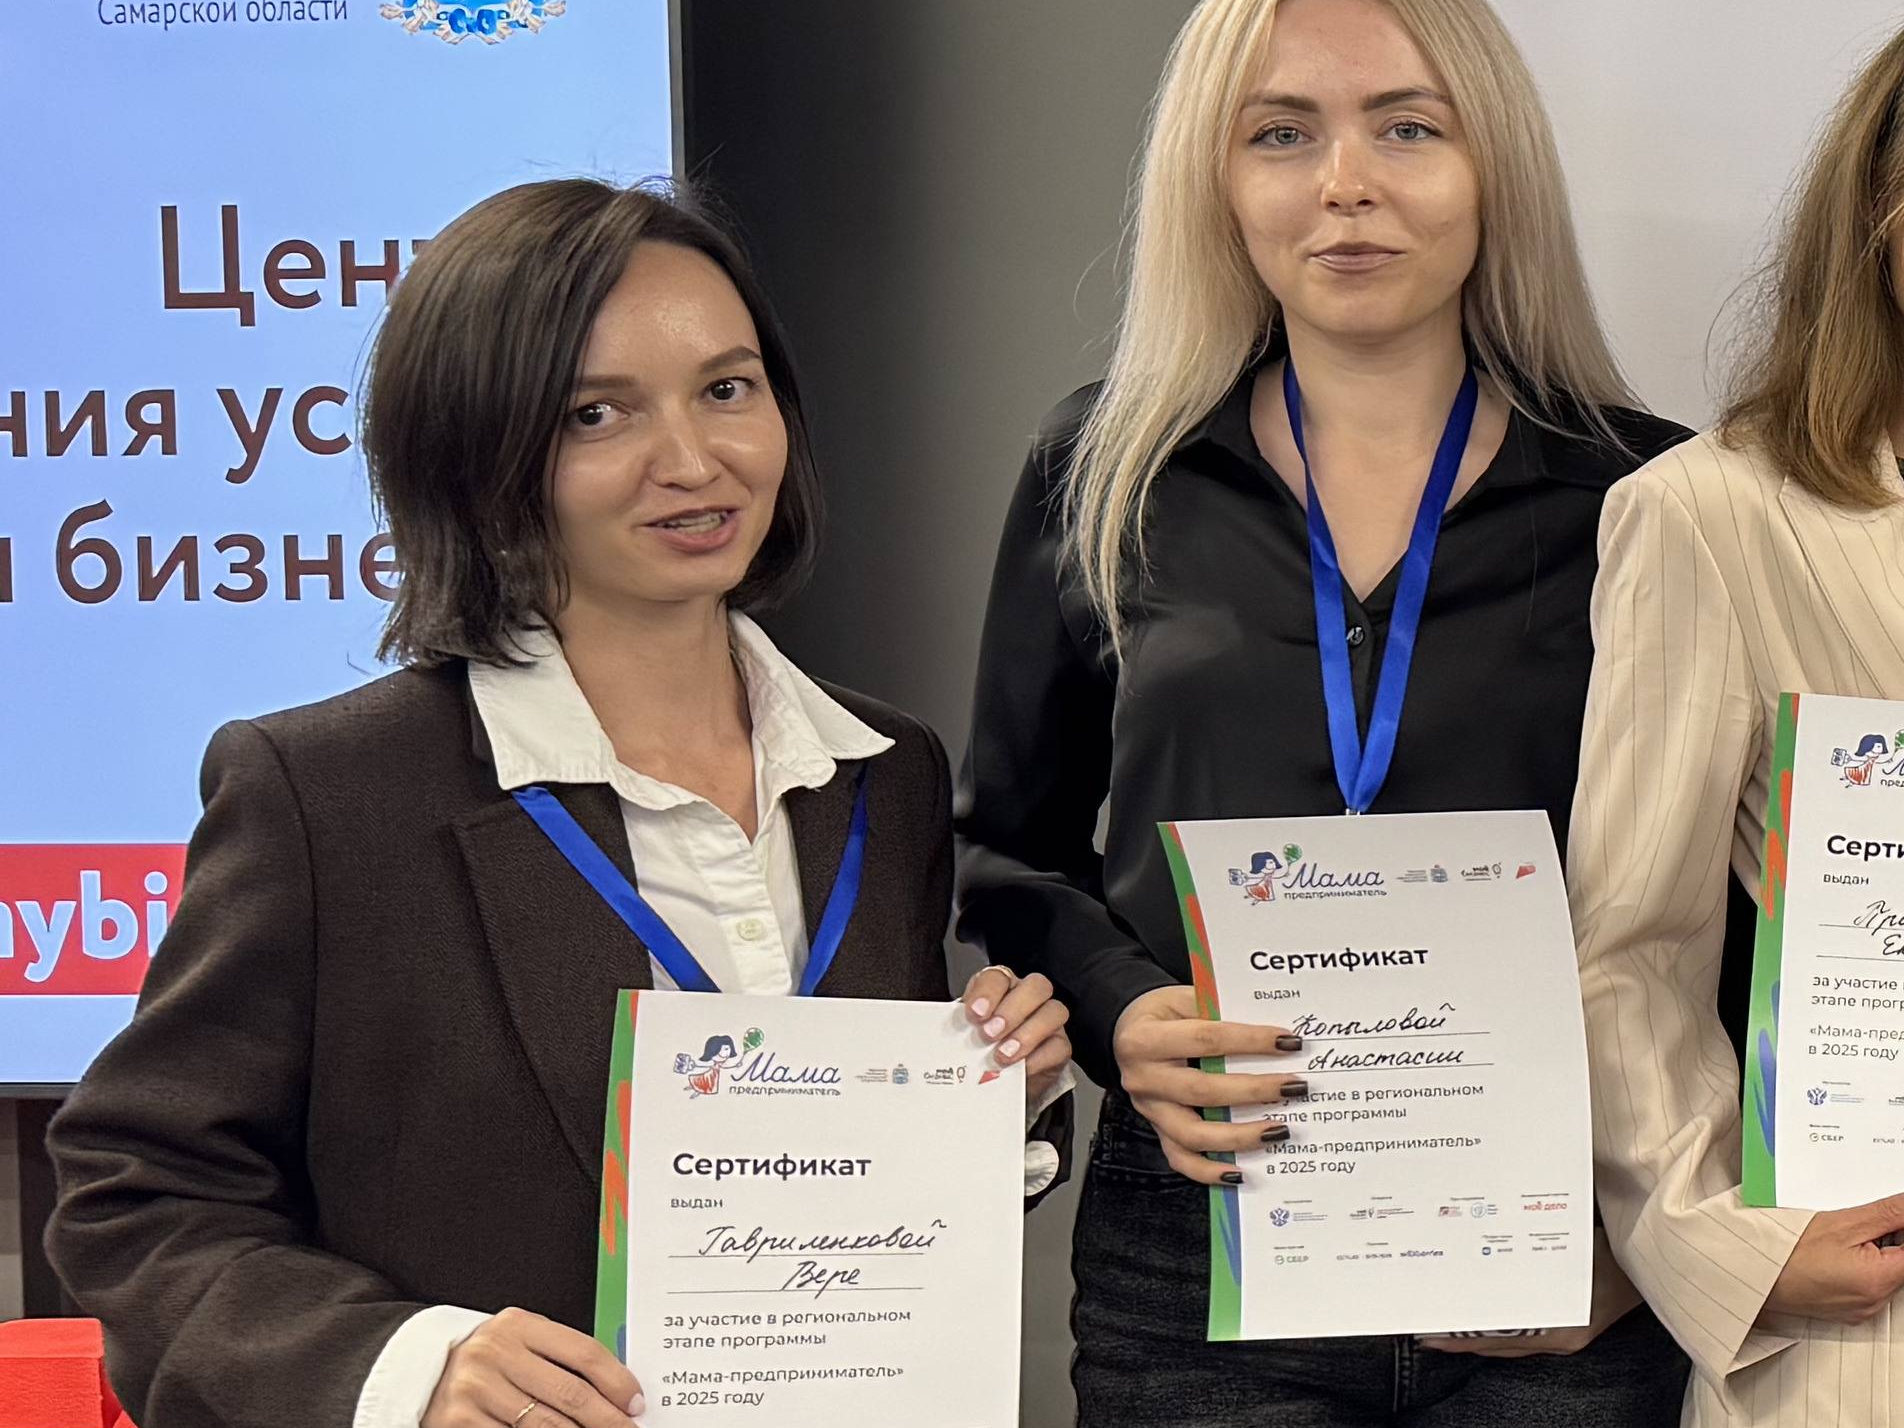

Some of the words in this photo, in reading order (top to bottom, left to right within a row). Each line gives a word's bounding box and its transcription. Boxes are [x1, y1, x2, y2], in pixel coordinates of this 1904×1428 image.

[160, 204, 431, 327] Цен
[1282, 862, 1384, 889] Мама
[1823, 873, 1869, 885] выдан
[1249, 946, 1428, 974] Сертификат
[1812, 976, 1829, 986] за
[1833, 977, 1897, 990] участие
[1253, 989, 1300, 1000] выдан
[1811, 995, 1856, 1006] этапе
[1307, 1048, 1463, 1070] Анастасии
[1808, 1044, 1816, 1054] в
[1821, 1042, 1858, 1056] 2025
[1863, 1047, 1898, 1061] году
[730, 1050, 841, 1083] Мама
[1352, 1091, 1360, 1100] в
[1365, 1084, 1484, 1102] региональном
[1263, 1112, 1307, 1123] этапе
[1313, 1109, 1407, 1122] программы
[672, 1152, 871, 1181] Сертификат
[1267, 1164, 1275, 1174] в
[1280, 1161, 1316, 1174] 2025
[1321, 1161, 1356, 1175] году
[670, 1197, 723, 1209] выдан
[780, 1260, 860, 1299] Вере
[663, 1315, 684, 1327] за
[687, 1314, 761, 1330] участие
[766, 1313, 776, 1324] в
[782, 1311, 910, 1326] региональном
[663, 1336, 715, 1348] этапе
[720, 1334, 825, 1349] программы
[660, 1395, 671, 1406] в
[676, 1390, 719, 1405] 2025
[724, 1392, 764, 1406] году
